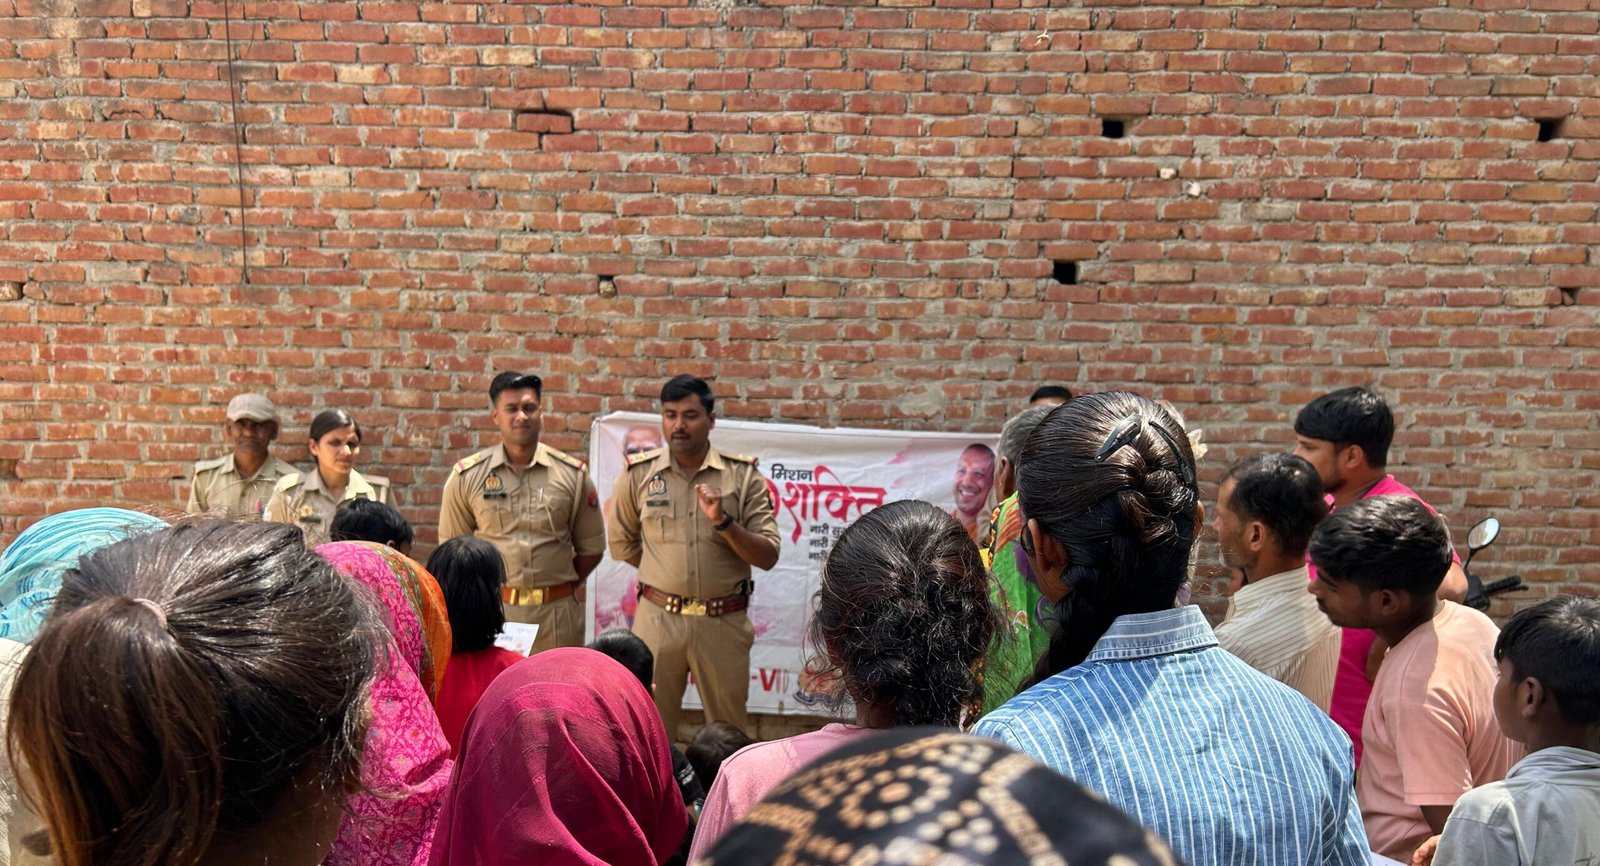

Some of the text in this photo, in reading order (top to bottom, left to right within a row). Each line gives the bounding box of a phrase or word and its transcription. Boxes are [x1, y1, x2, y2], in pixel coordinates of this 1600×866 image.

[771, 463, 813, 481] मिशन
[810, 523, 829, 535] नारी
[809, 536, 828, 548] नारी
